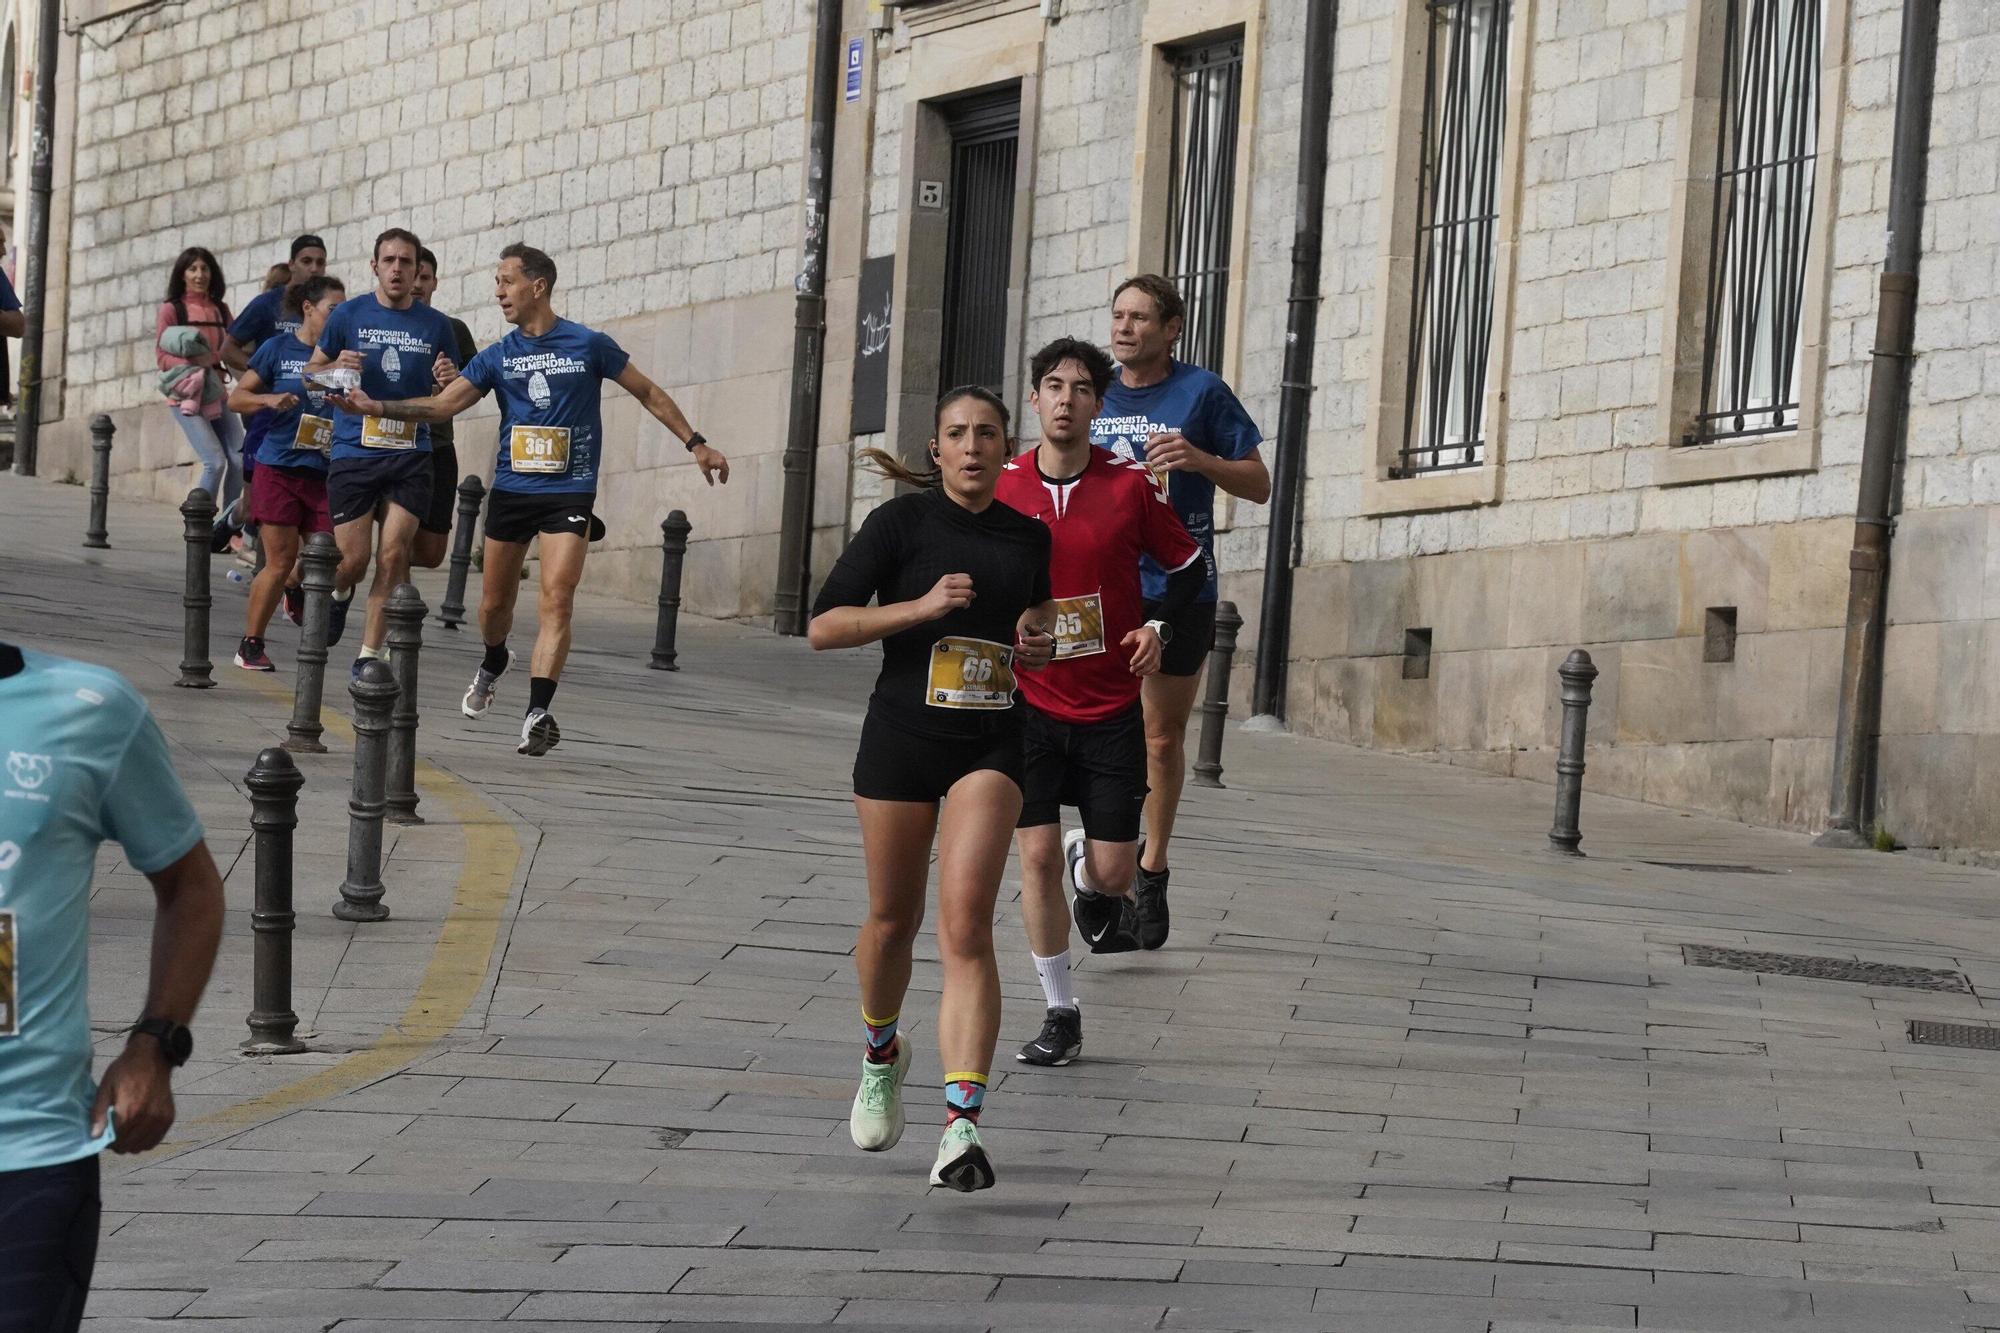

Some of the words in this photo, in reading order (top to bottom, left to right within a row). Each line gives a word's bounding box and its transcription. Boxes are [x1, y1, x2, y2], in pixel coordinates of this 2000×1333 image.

[924, 184, 938, 203] 5
[368, 328, 410, 338] CONQUISTA
[369, 335, 424, 347] ALMENDRA
[512, 353, 556, 364] CONQUISTA
[514, 357, 573, 372] ALMENDRA
[545, 365, 586, 376] KONKISTA
[1095, 415, 1148, 426] CONQUISTA
[1095, 423, 1168, 436] ALMENDRA
[525, 437, 553, 455] 361
[1054, 612, 1082, 637] 65
[963, 656, 993, 682] 66
